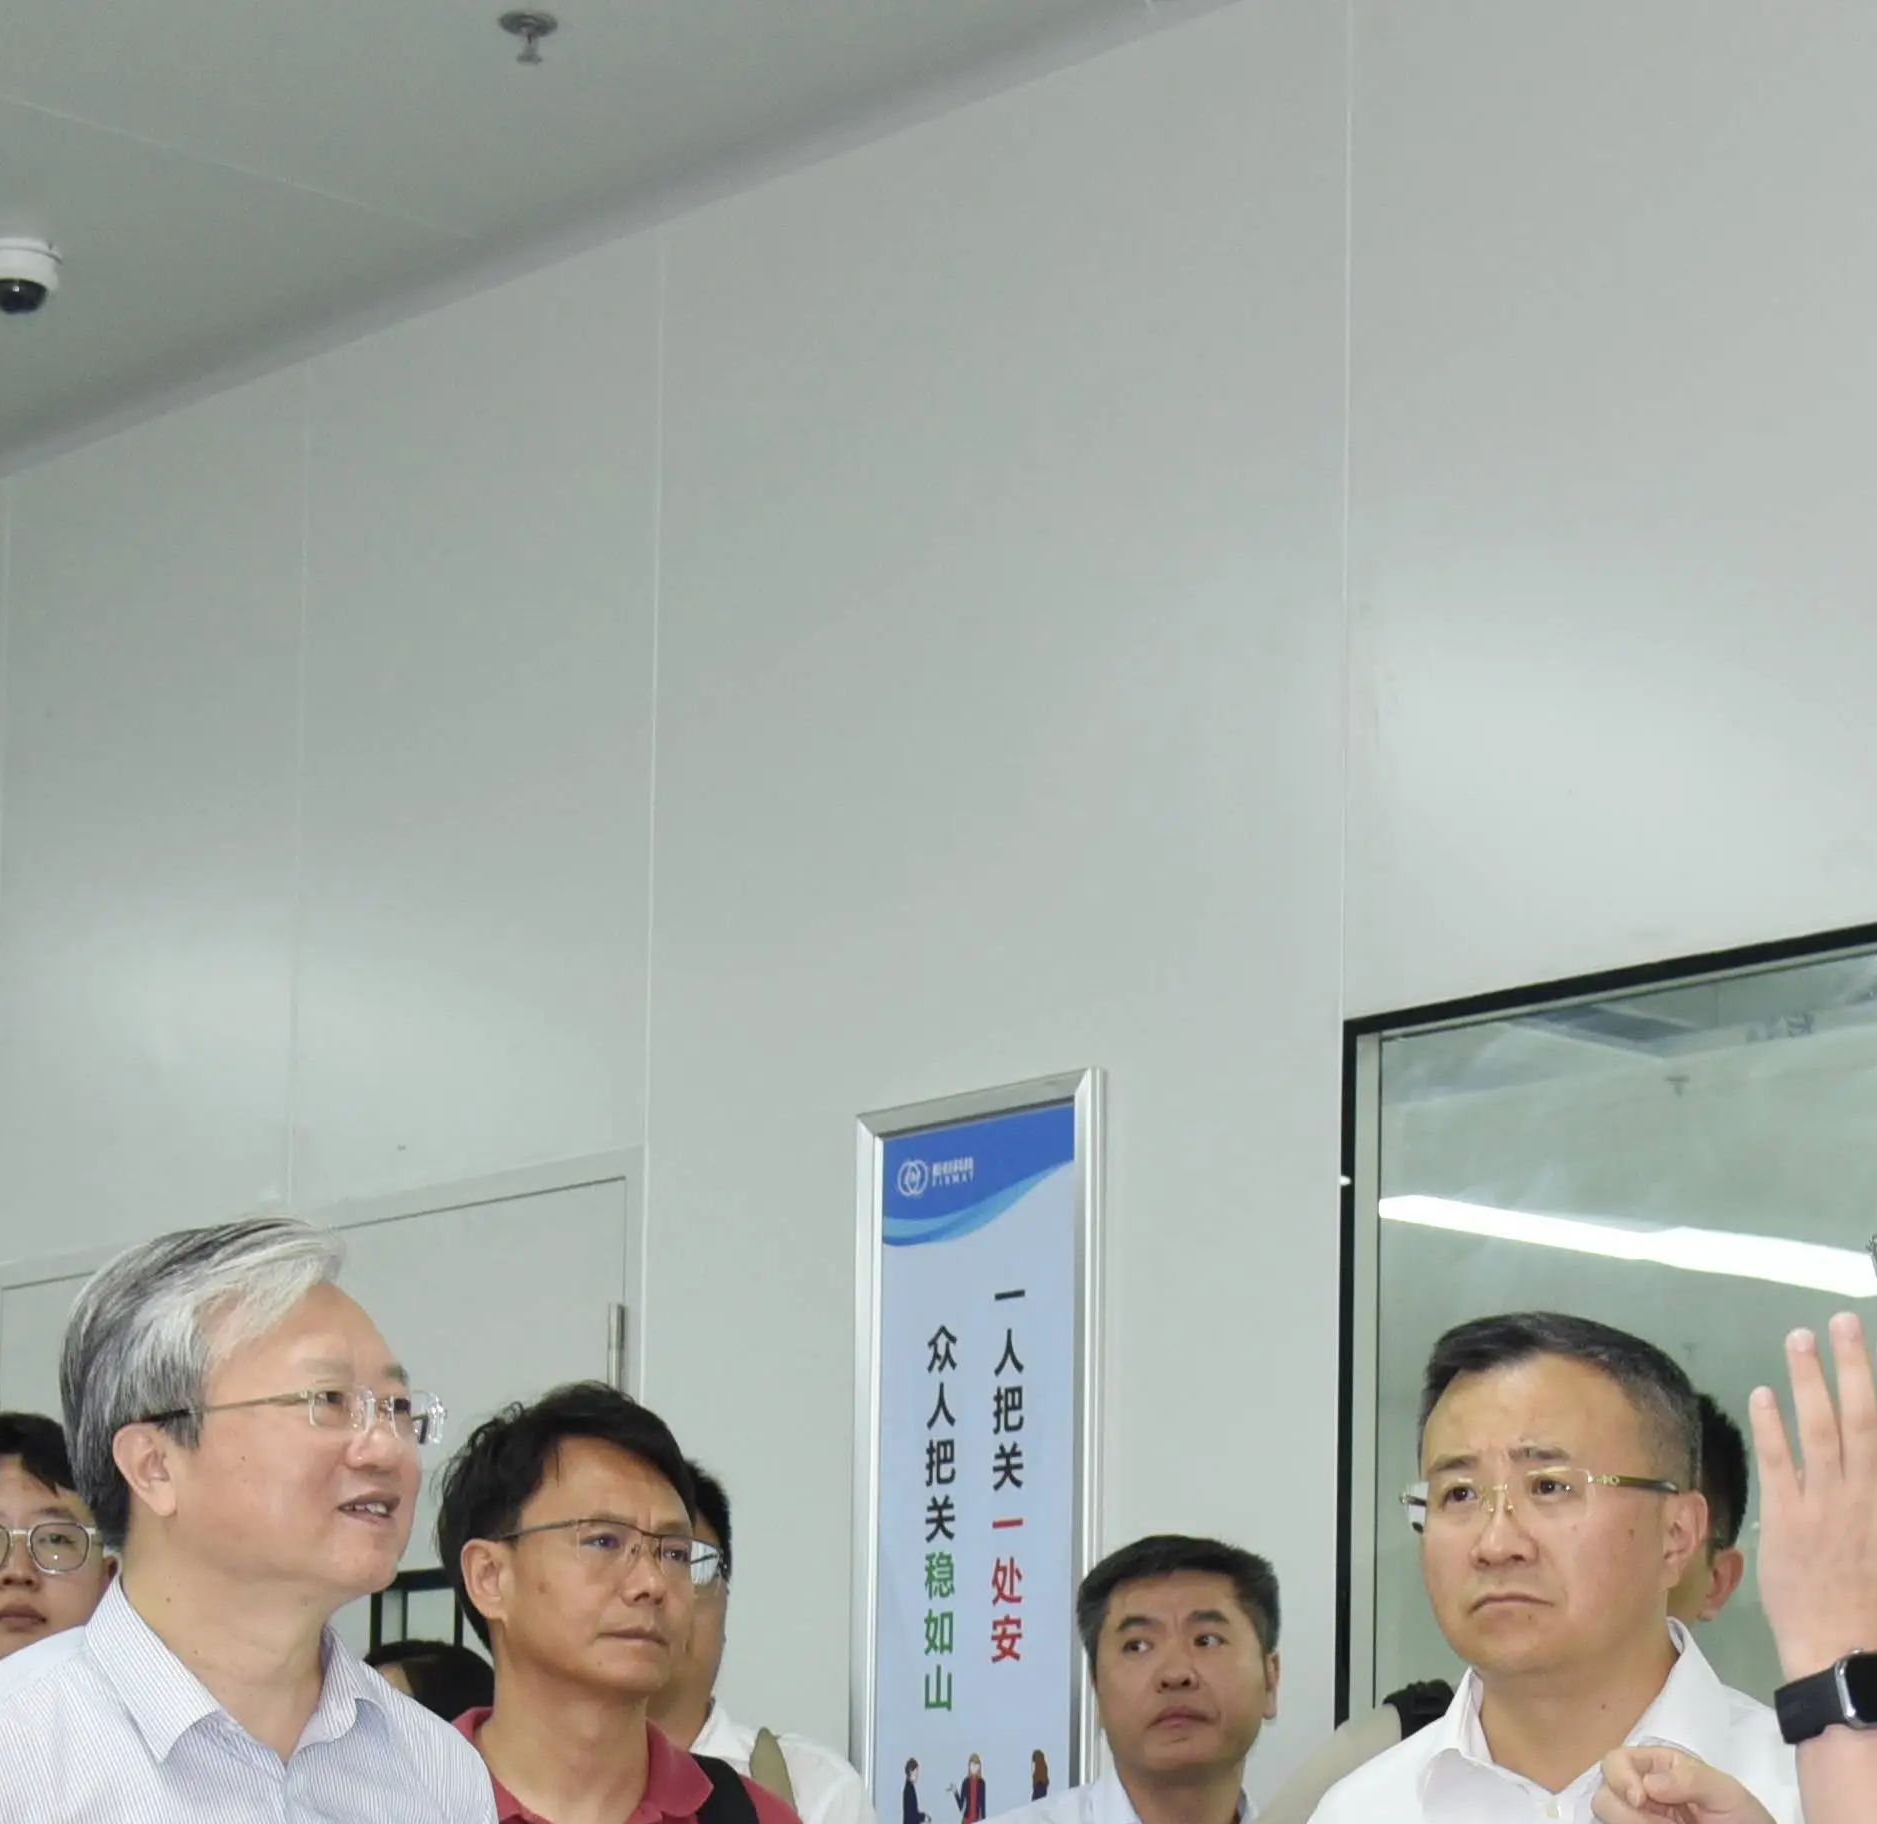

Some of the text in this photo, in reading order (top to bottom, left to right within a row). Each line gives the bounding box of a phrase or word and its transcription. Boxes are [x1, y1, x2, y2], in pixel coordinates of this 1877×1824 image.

[924, 1324, 958, 1711] 众人把关稳如山
[991, 1288, 1026, 1664] 一人把关一处安
